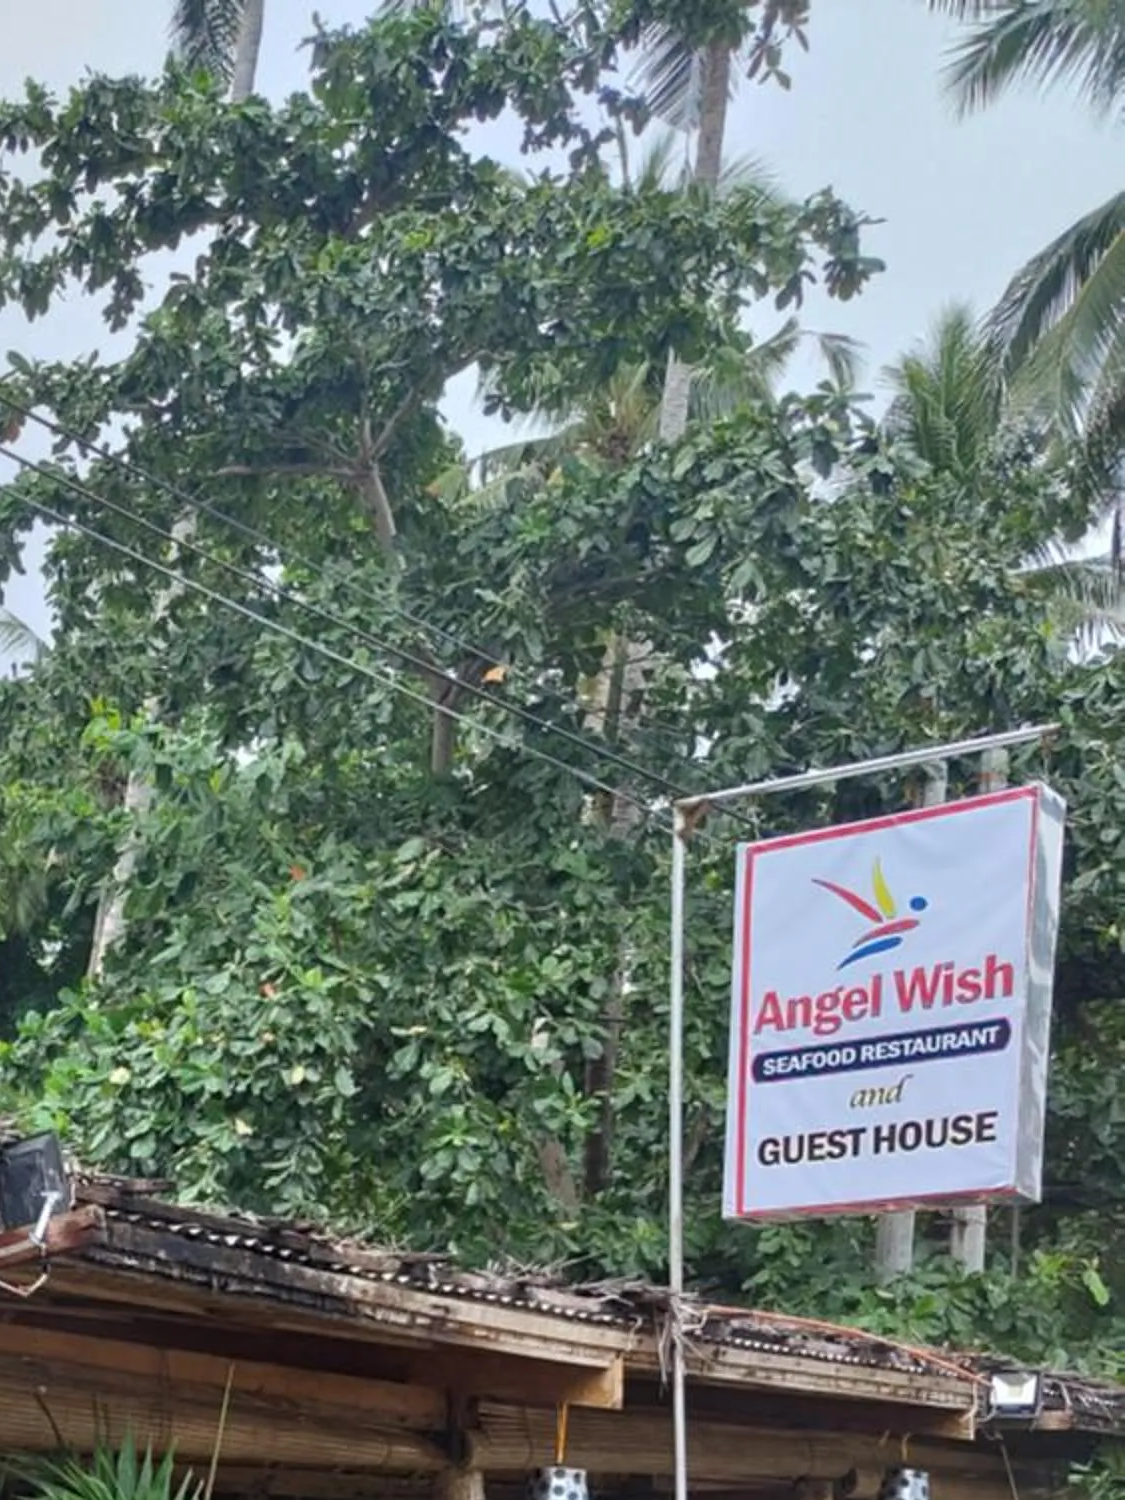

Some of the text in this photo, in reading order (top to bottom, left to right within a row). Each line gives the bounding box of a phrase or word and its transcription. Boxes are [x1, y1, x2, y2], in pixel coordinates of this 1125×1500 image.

[753, 953, 1015, 1036] Angel Wish
[762, 1025, 1001, 1076] SEAFOOD RESTAURANT
[849, 1074, 914, 1109] and
[757, 1111, 999, 1167] GUEST HOUSE
